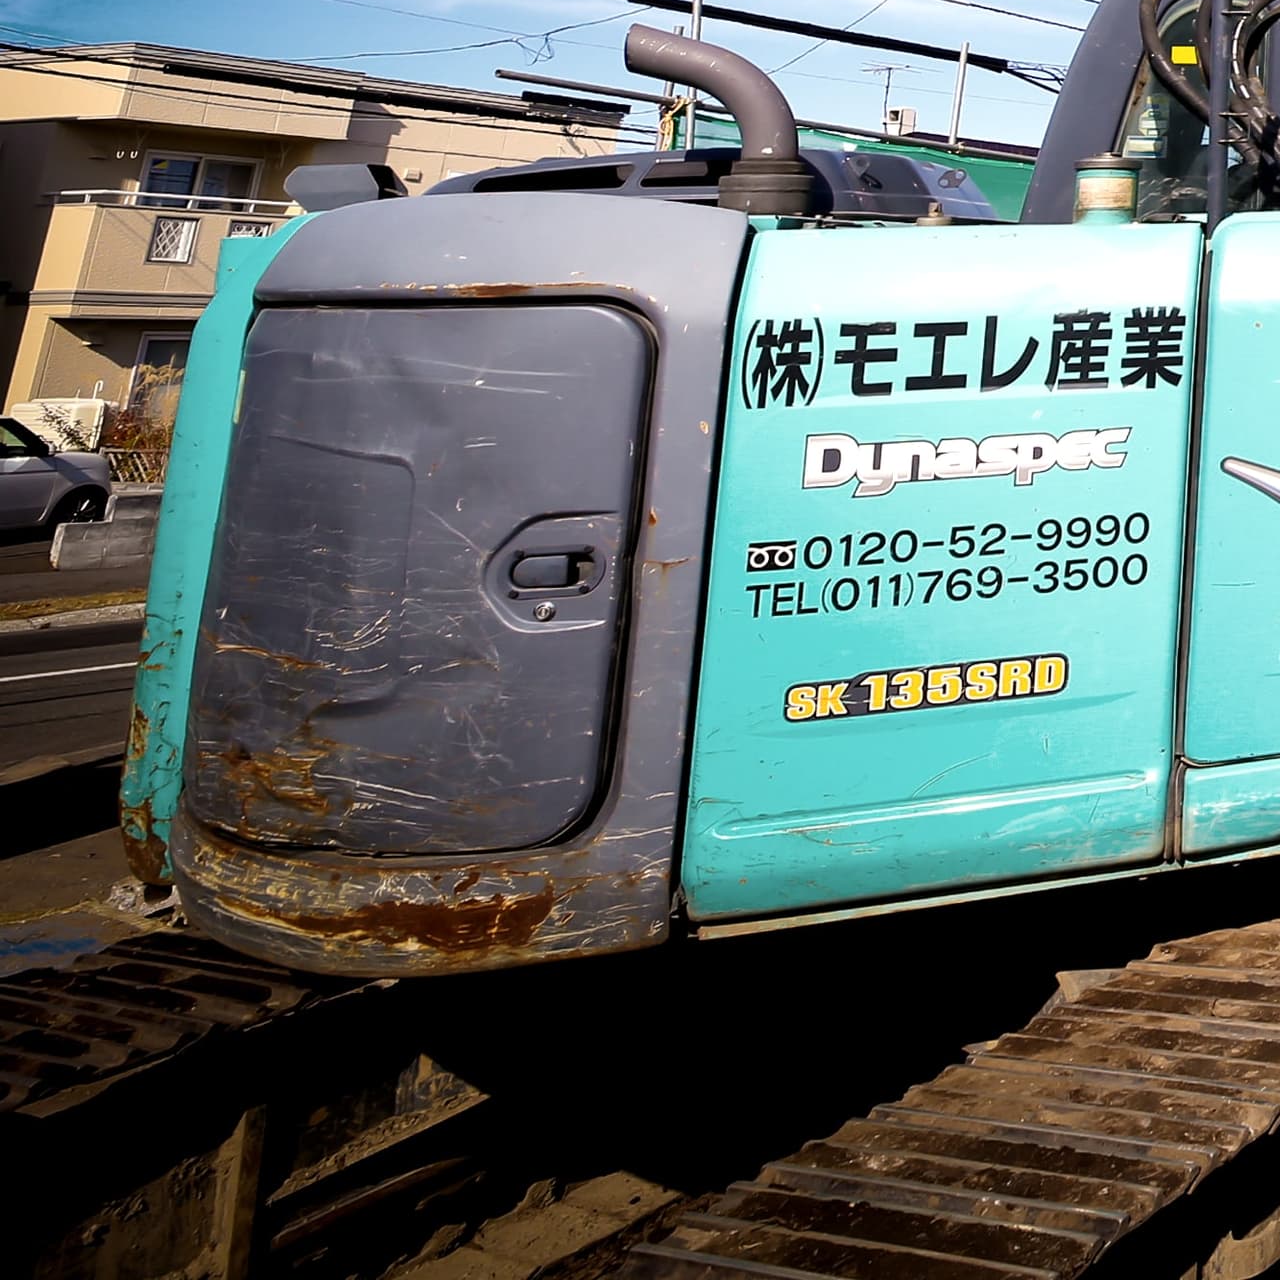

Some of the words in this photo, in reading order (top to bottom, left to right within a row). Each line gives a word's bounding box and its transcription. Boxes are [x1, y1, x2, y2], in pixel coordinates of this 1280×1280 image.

[742, 307, 1187, 410] (株)モエレ産業
[801, 426, 1132, 498] Dynaspec
[803, 512, 1150, 570] 0120-52-9990
[745, 554, 1149, 618] TEL(011)769-3500
[787, 684, 850, 719] SK
[861, 656, 1066, 710] 135SRD
